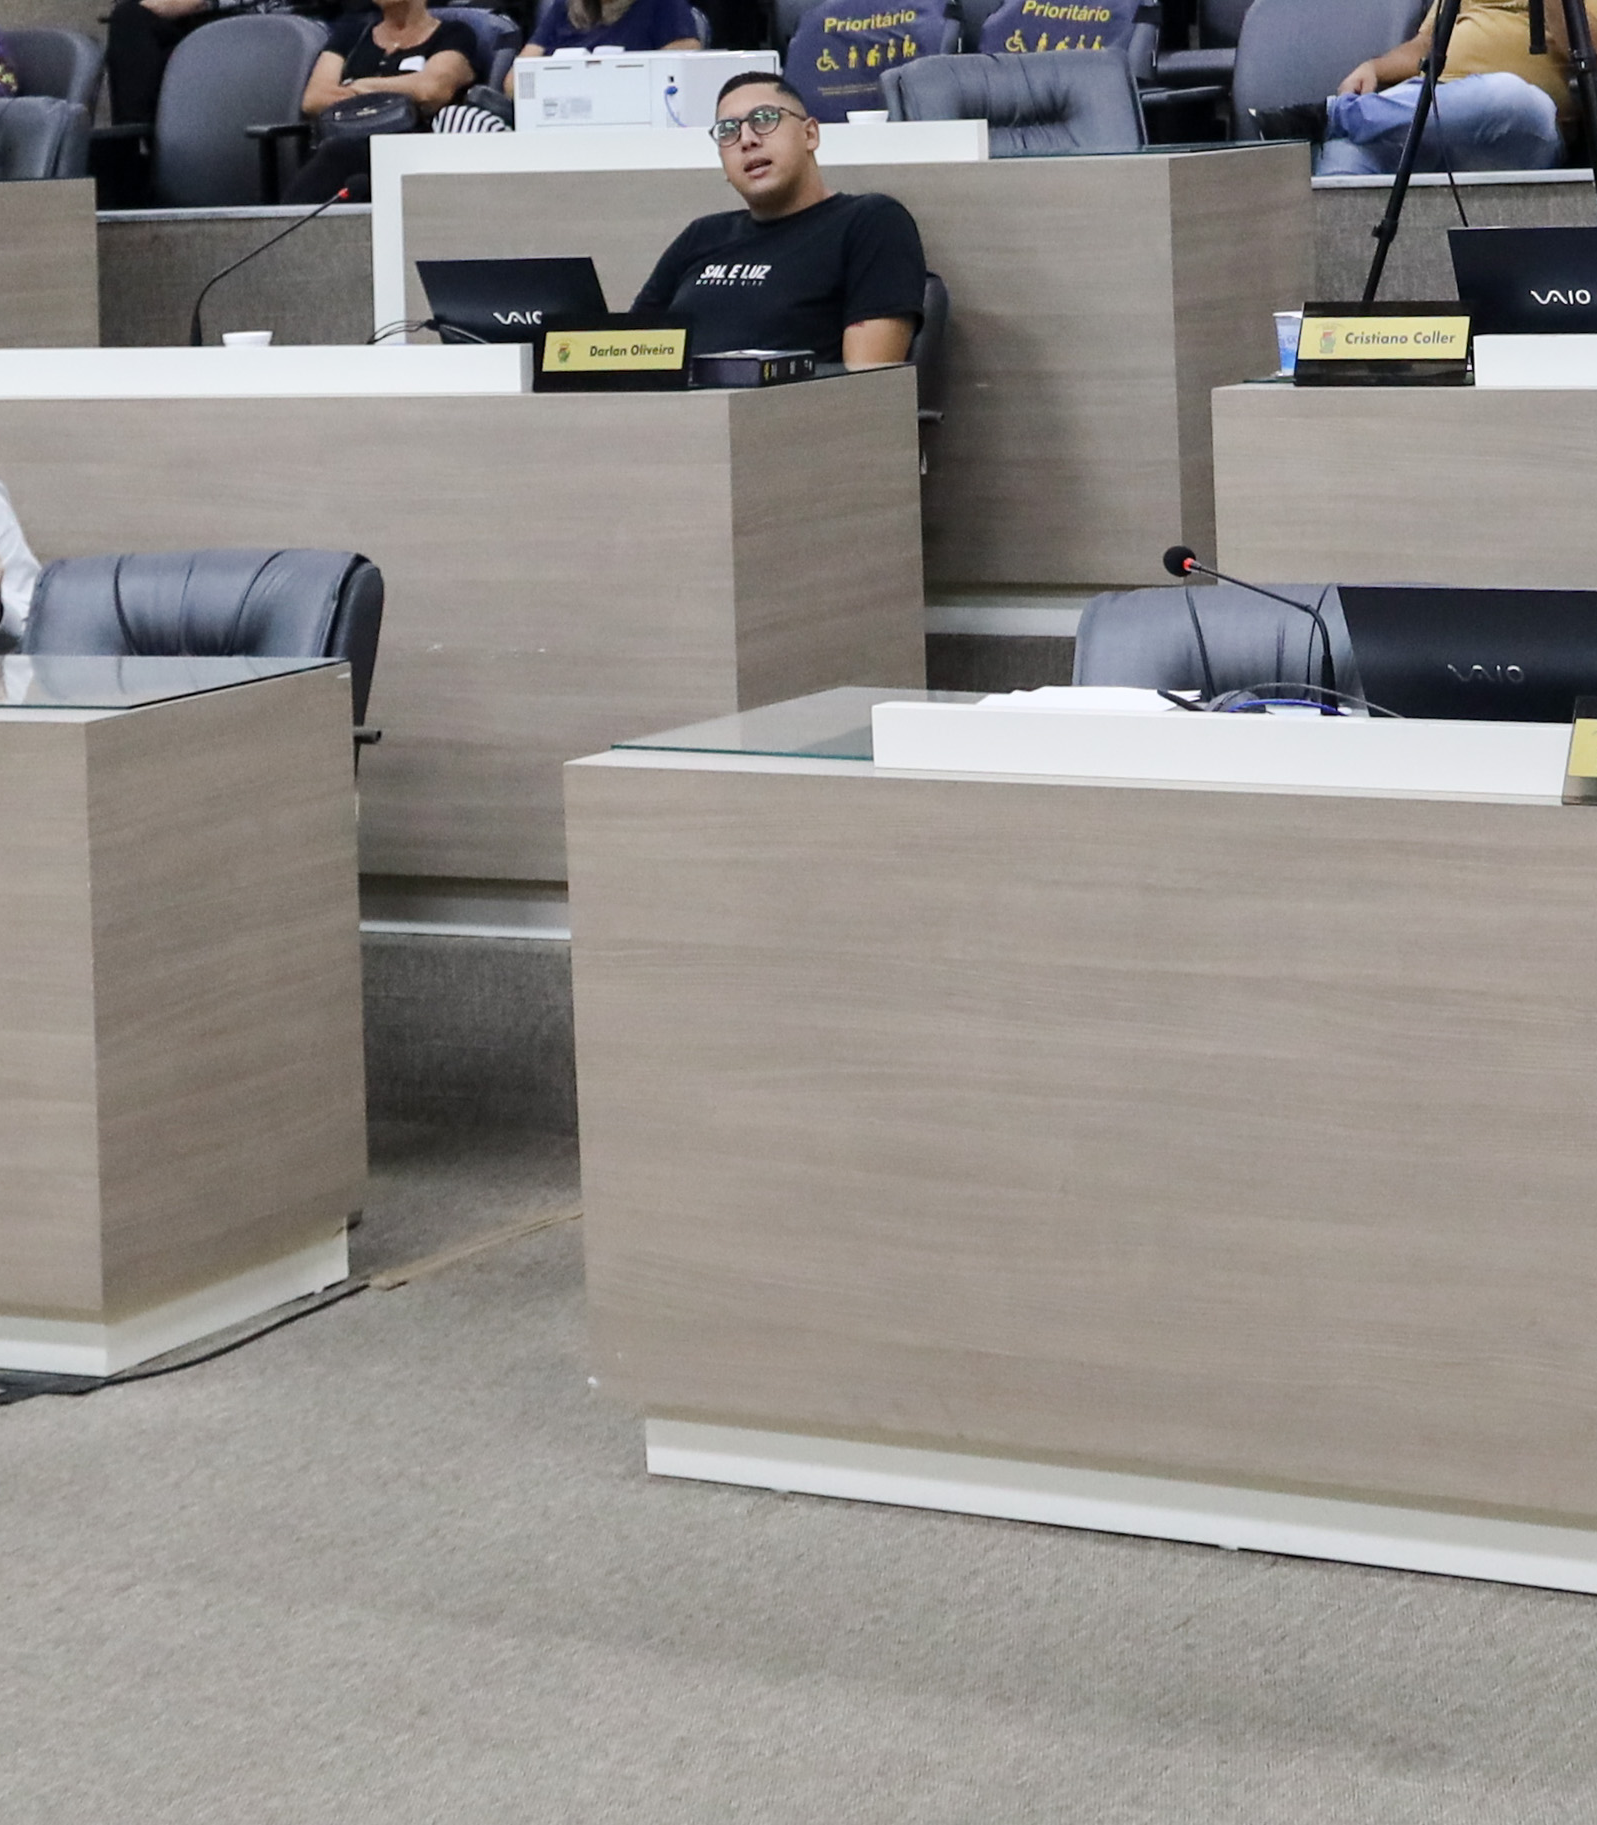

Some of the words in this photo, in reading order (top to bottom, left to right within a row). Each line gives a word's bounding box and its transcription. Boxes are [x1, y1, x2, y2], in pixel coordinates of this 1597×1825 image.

[1022, 0, 1111, 22] Prioritário
[824, 9, 916, 33] Prioritário
[700, 264, 728, 279] SAL
[728, 264, 743, 278] E
[740, 264, 772, 279] LUZ
[1530, 289, 1591, 305] VAIO
[1345, 330, 1408, 345] Cristiano
[1413, 330, 1456, 345] Coller
[590, 345, 627, 357] Darlan
[631, 344, 675, 356] Oliveira
[1447, 664, 1525, 683] VAIO
